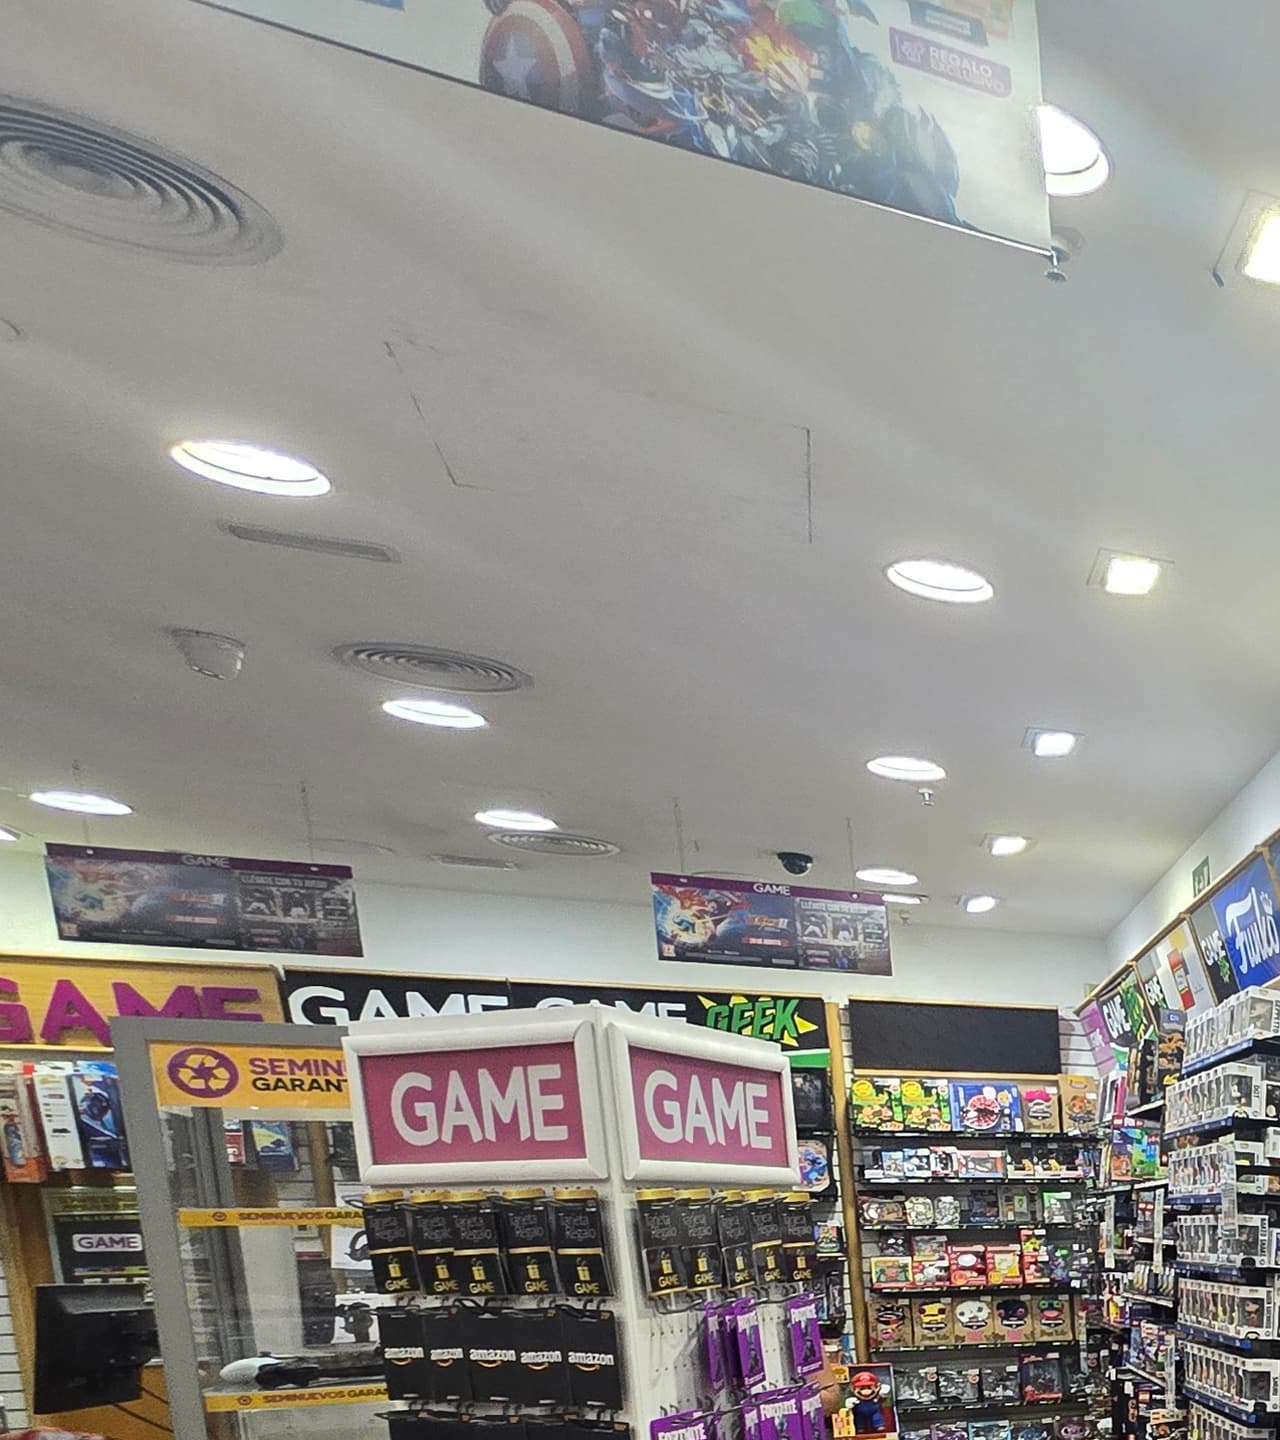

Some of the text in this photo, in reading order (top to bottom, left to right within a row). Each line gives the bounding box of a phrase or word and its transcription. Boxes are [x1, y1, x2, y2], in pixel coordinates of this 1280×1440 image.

[929, 45, 995, 80] REGALO
[930, 58, 1007, 94] EXCLUSIVO
[753, 882, 791, 896] GAME
[1226, 889, 1280, 974] Funko
[705, 995, 805, 1042] GEEK
[391, 1064, 567, 1148] GAME
[643, 1070, 773, 1150] GAME
[78, 1234, 140, 1250] GAME
[568, 1352, 614, 1365] amazon
